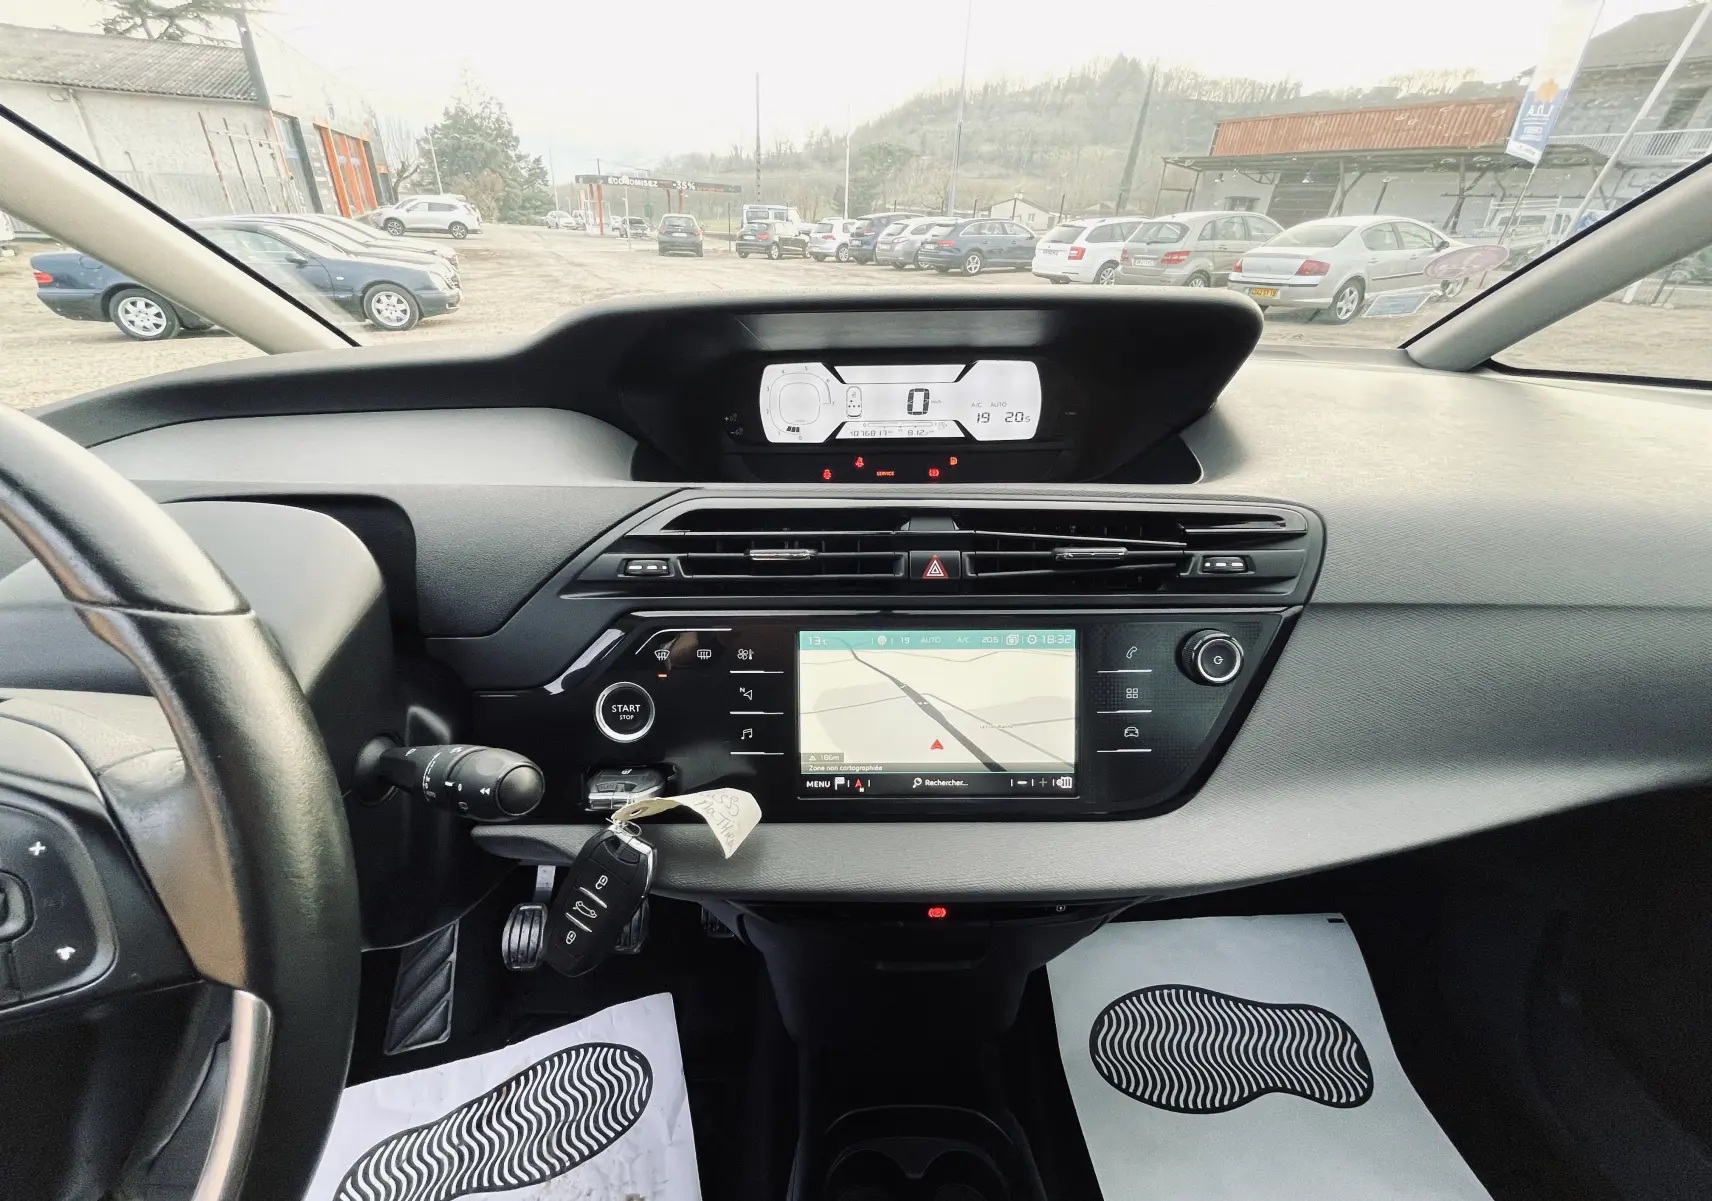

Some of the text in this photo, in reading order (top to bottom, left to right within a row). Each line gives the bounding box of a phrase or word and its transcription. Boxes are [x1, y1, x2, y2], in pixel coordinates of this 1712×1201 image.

[907, 388, 930, 415] 0
[976, 412, 990, 424] 19
[1042, 635, 1073, 644] 18:32
[611, 704, 641, 713] START
[839, 764, 883, 773] cartographiée
[806, 780, 831, 788] MENU
